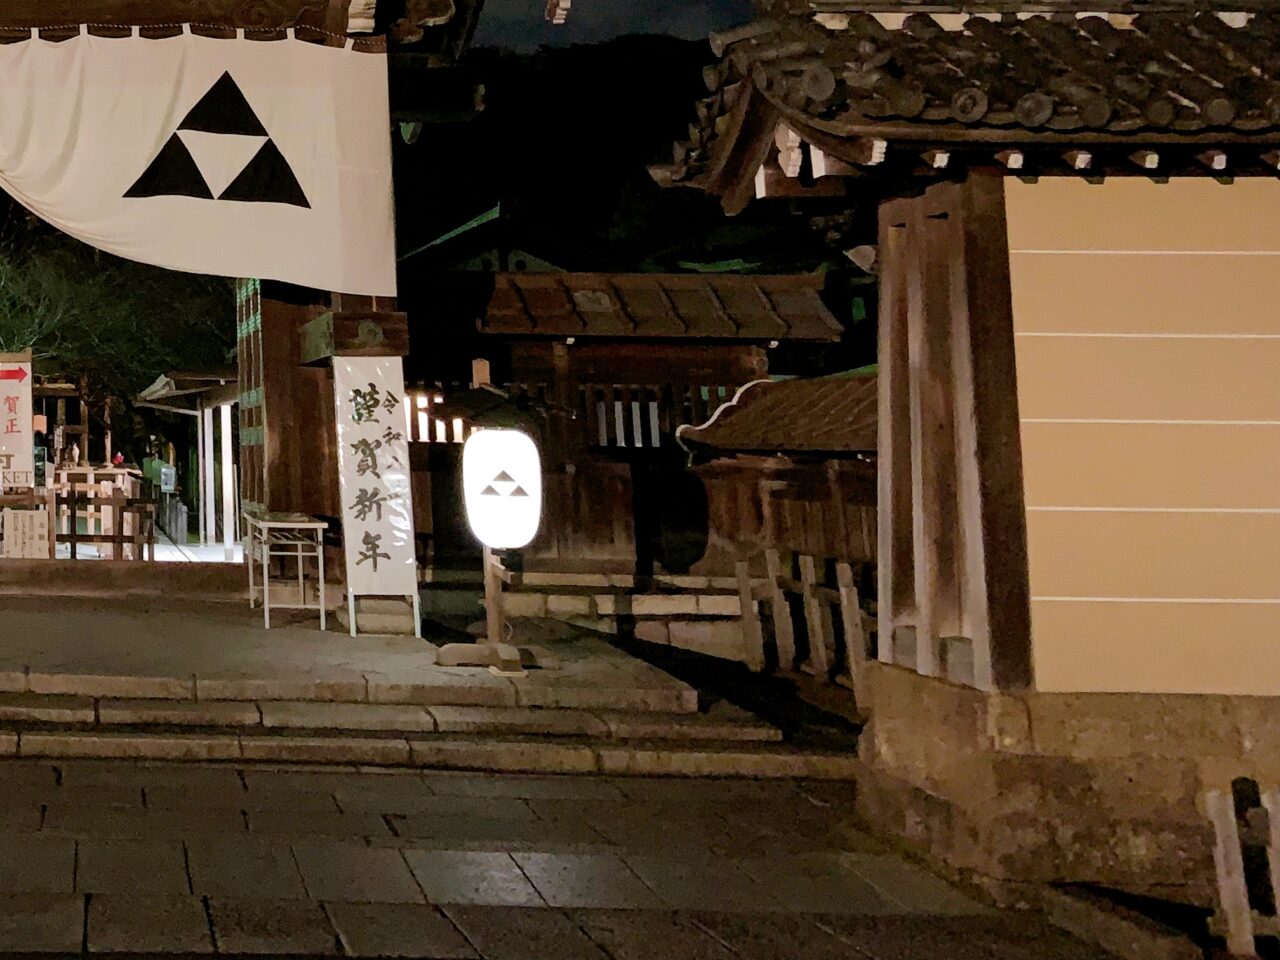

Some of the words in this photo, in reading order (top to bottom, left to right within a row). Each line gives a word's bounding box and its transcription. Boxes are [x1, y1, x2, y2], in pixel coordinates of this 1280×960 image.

[4, 395, 22, 434] 賀正
[348, 382, 391, 572] 謹賀新年
